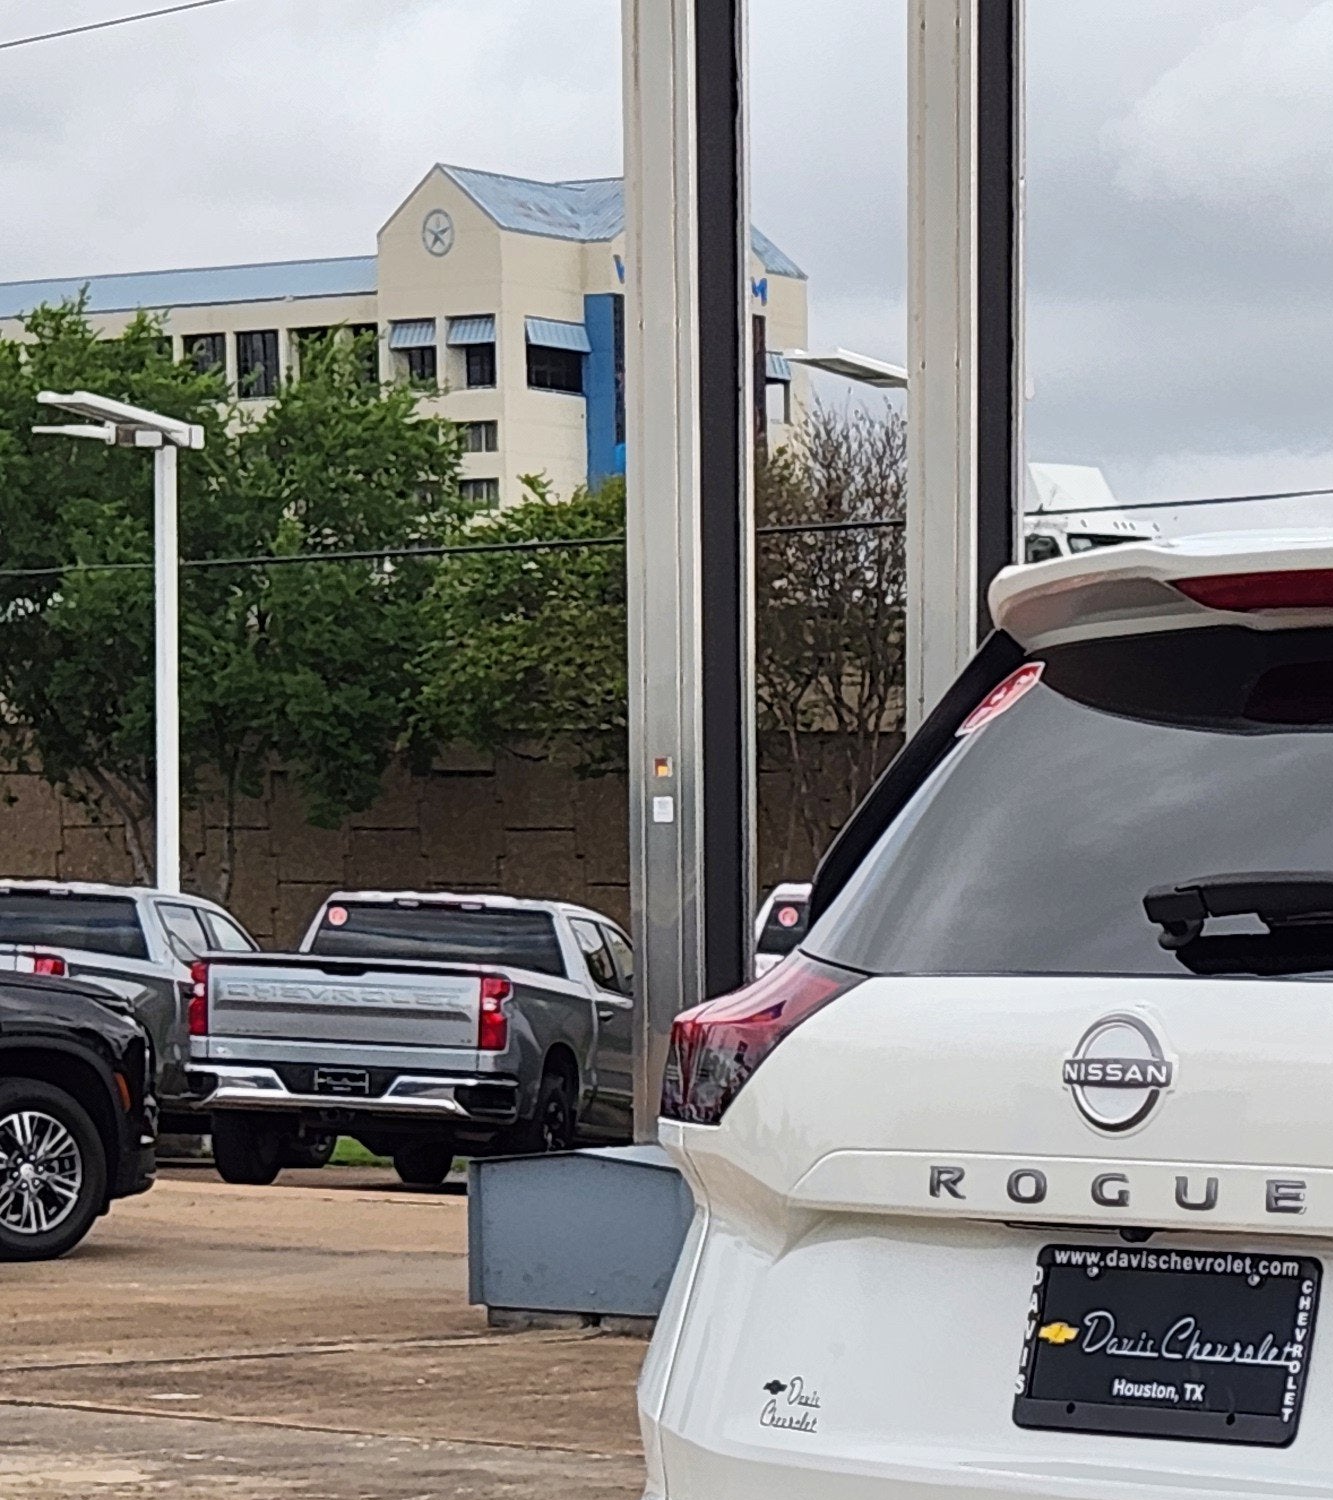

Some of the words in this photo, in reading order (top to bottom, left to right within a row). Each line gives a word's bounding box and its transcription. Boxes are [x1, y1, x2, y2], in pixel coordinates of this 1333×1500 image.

[1064, 1060, 1167, 1084] NISSAN
[929, 1164, 1308, 1216] ROGUE
[1054, 1248, 1300, 1278] www.davischevrolet.com
[1013, 1264, 1043, 1395] DAVIS
[1082, 1310, 1159, 1359] Davis
[1160, 1316, 1294, 1366] Chevrolet
[1280, 1279, 1313, 1423] CHEVROLET
[1112, 1377, 1180, 1402] Houston,
[1184, 1382, 1206, 1402] TX
